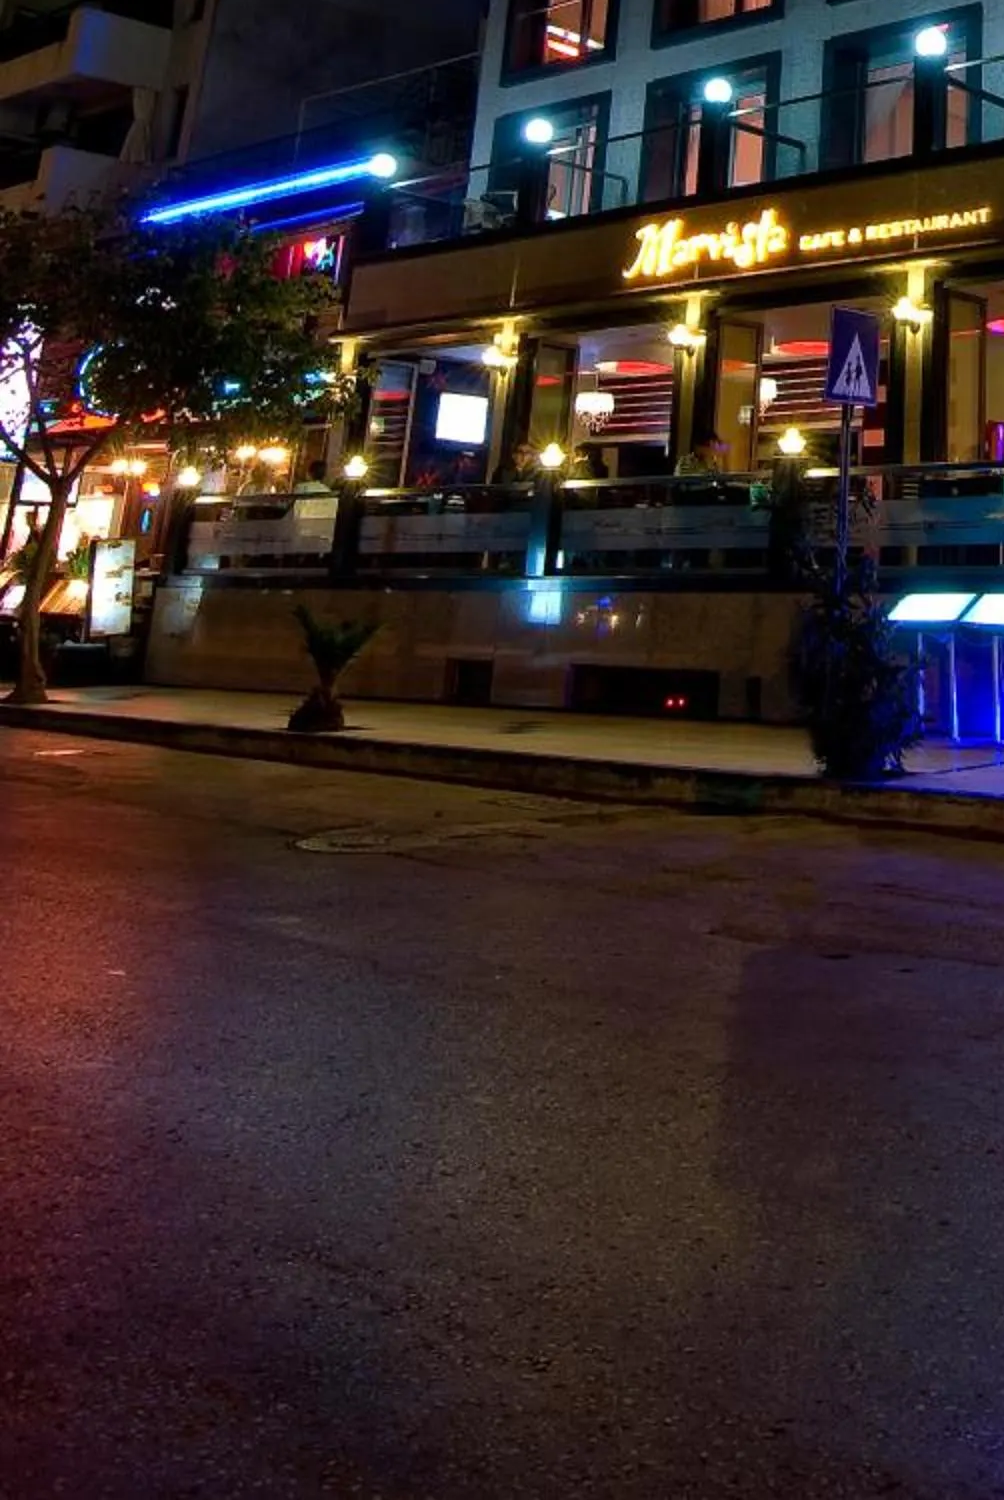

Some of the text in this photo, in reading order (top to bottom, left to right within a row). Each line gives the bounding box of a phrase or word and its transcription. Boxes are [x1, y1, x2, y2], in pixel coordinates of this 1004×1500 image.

[800, 230, 845, 250] CAFE
[847, 227, 863, 244] &
[865, 207, 991, 241] RESTAURANT
